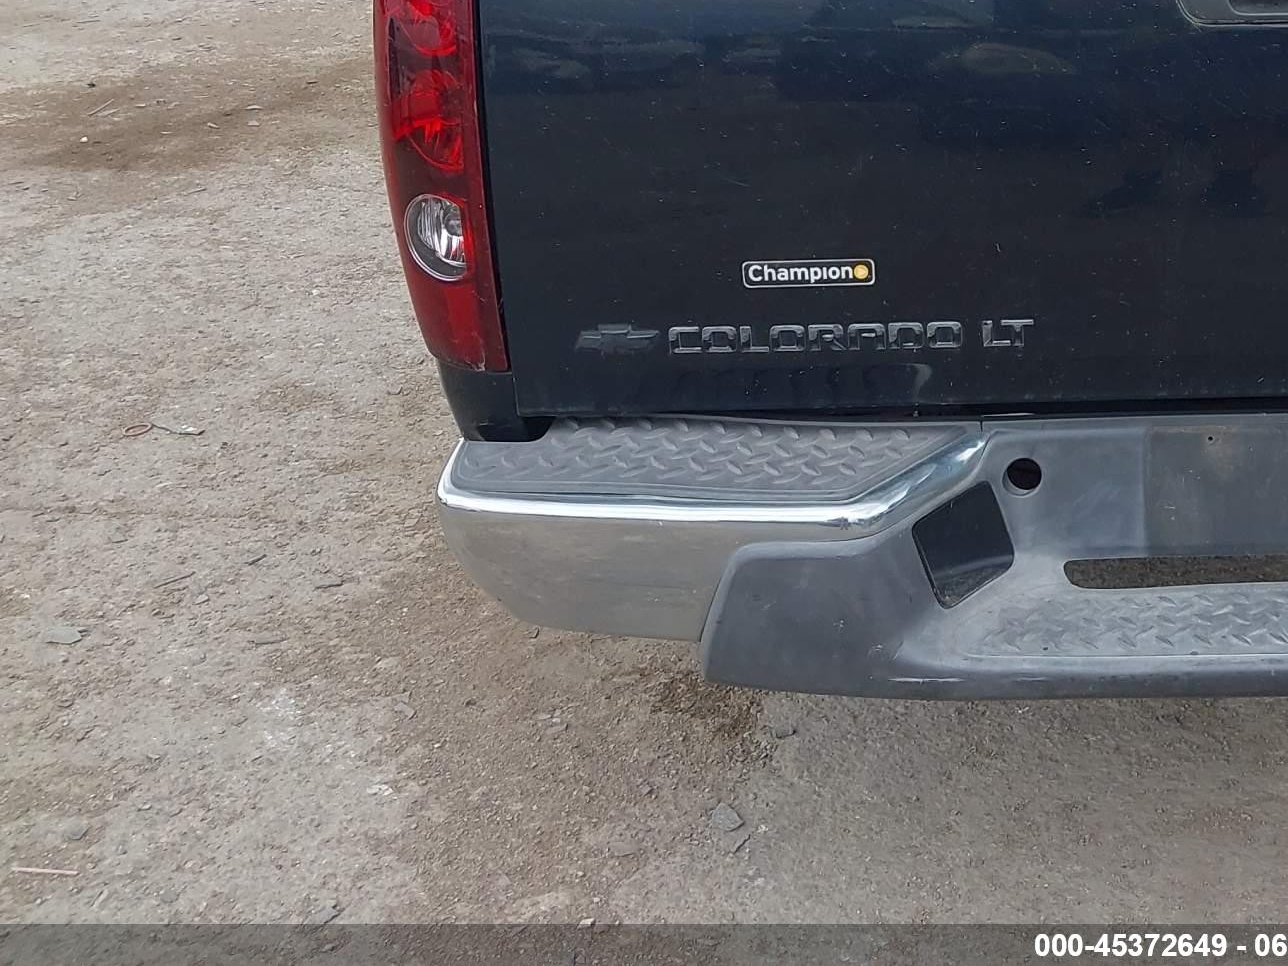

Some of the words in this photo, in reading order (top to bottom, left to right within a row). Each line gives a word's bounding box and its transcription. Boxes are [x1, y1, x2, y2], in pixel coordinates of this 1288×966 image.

[747, 264, 854, 284] Champion
[668, 321, 963, 353] COLORADO
[982, 318, 1034, 348] LT
